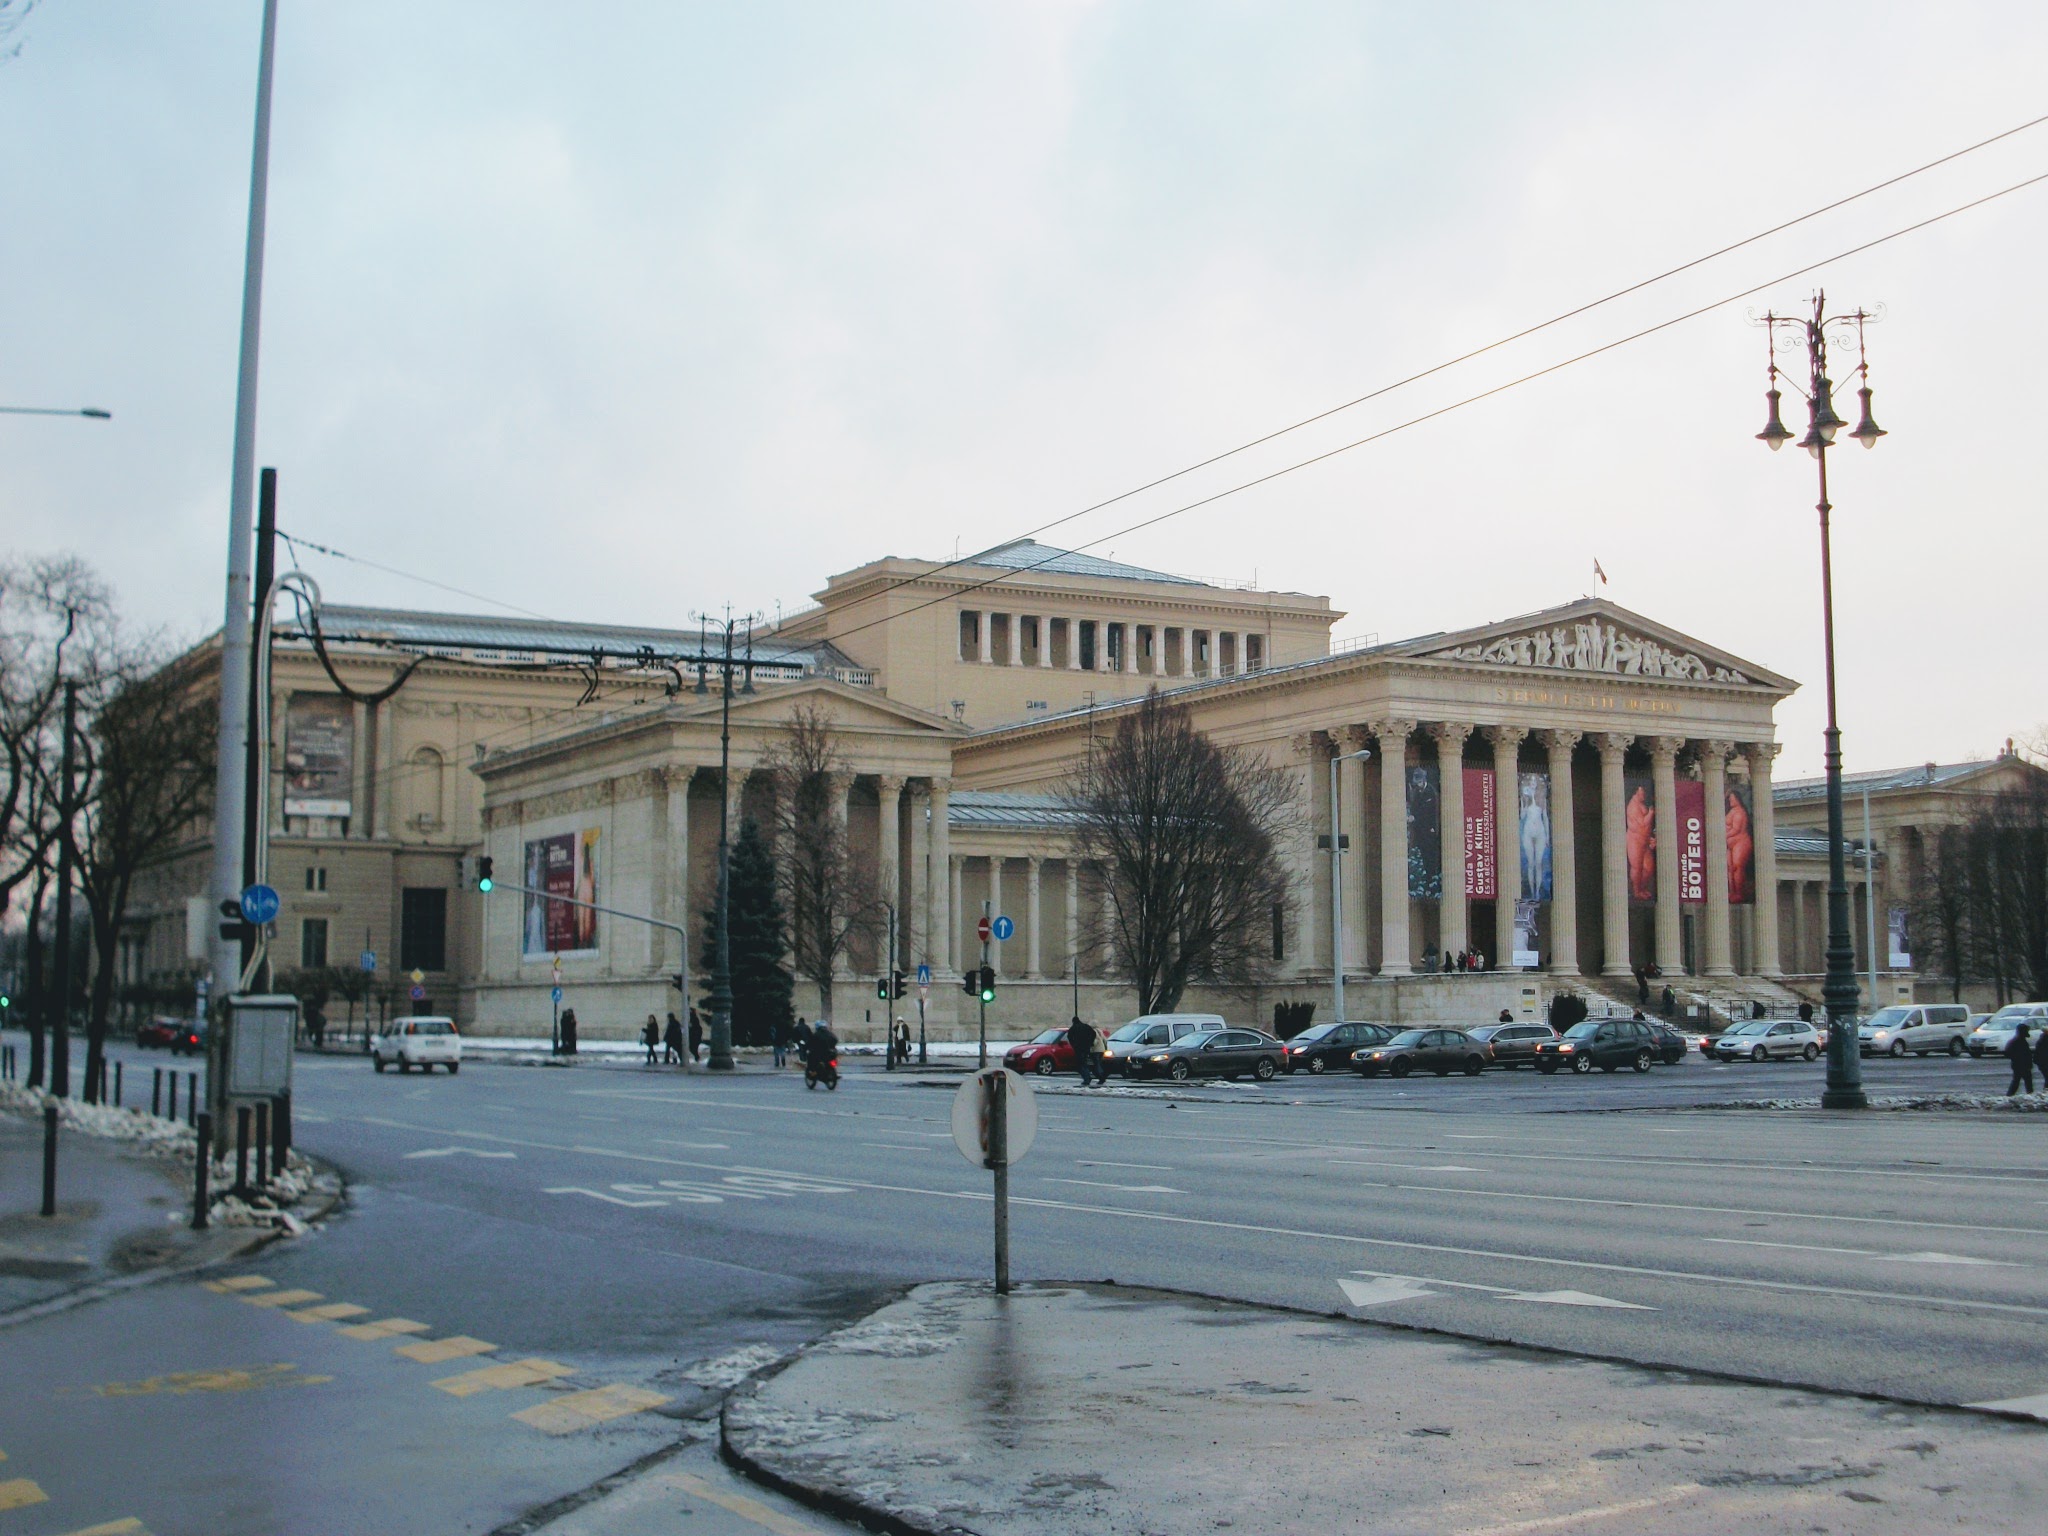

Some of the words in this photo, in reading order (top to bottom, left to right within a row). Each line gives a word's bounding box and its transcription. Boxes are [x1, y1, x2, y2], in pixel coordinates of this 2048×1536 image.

[1465, 817, 1473, 858] Veritas
[1475, 818, 1483, 849] Klimt
[1465, 863, 1474, 894] Nuda
[1475, 854, 1484, 894] Gustav
[1687, 818, 1702, 899] BOTERO
